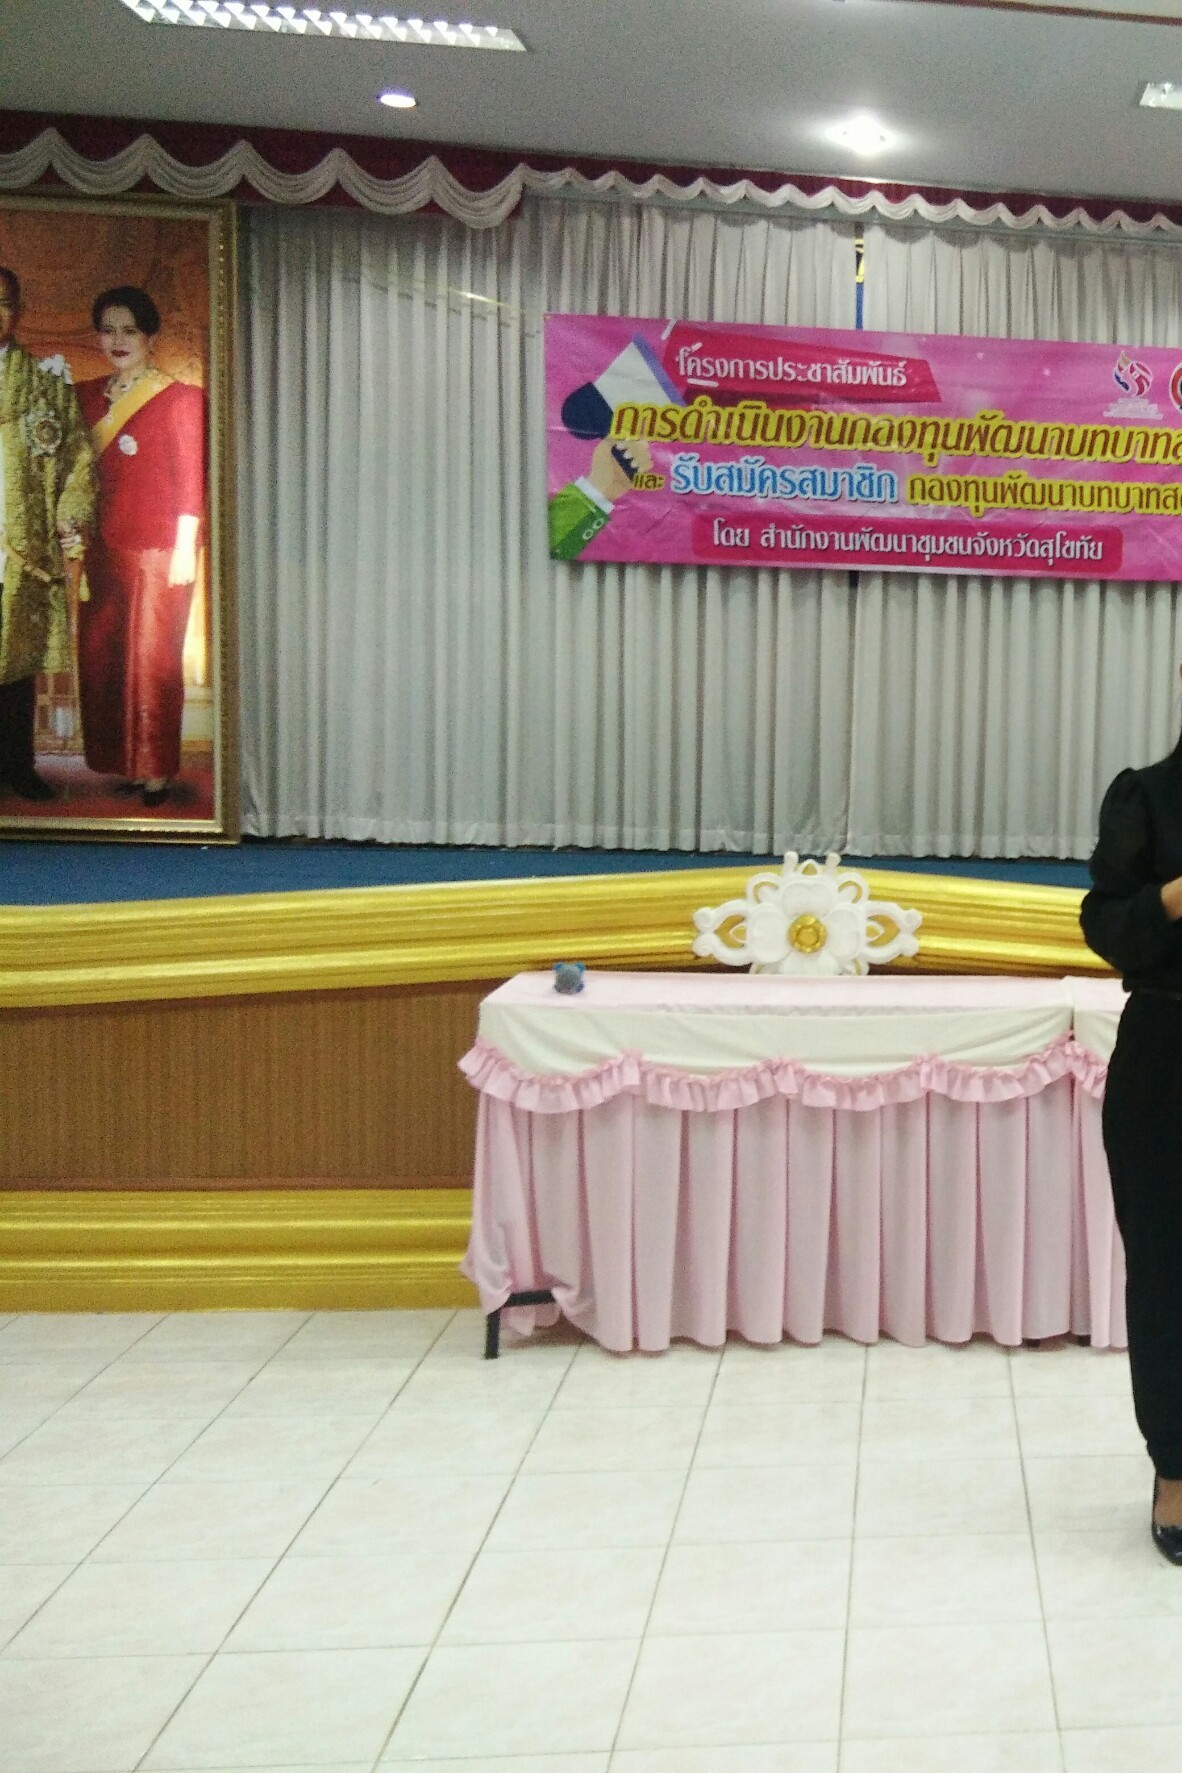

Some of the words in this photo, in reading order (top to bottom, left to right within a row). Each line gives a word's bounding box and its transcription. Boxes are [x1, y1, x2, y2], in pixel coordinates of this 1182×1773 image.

[676, 346, 908, 387] โครงการประชาสัมพันธ์
[633, 473, 663, 490] และ
[672, 453, 898, 501] รับสมัครสมาชิก
[713, 517, 750, 548] โดย
